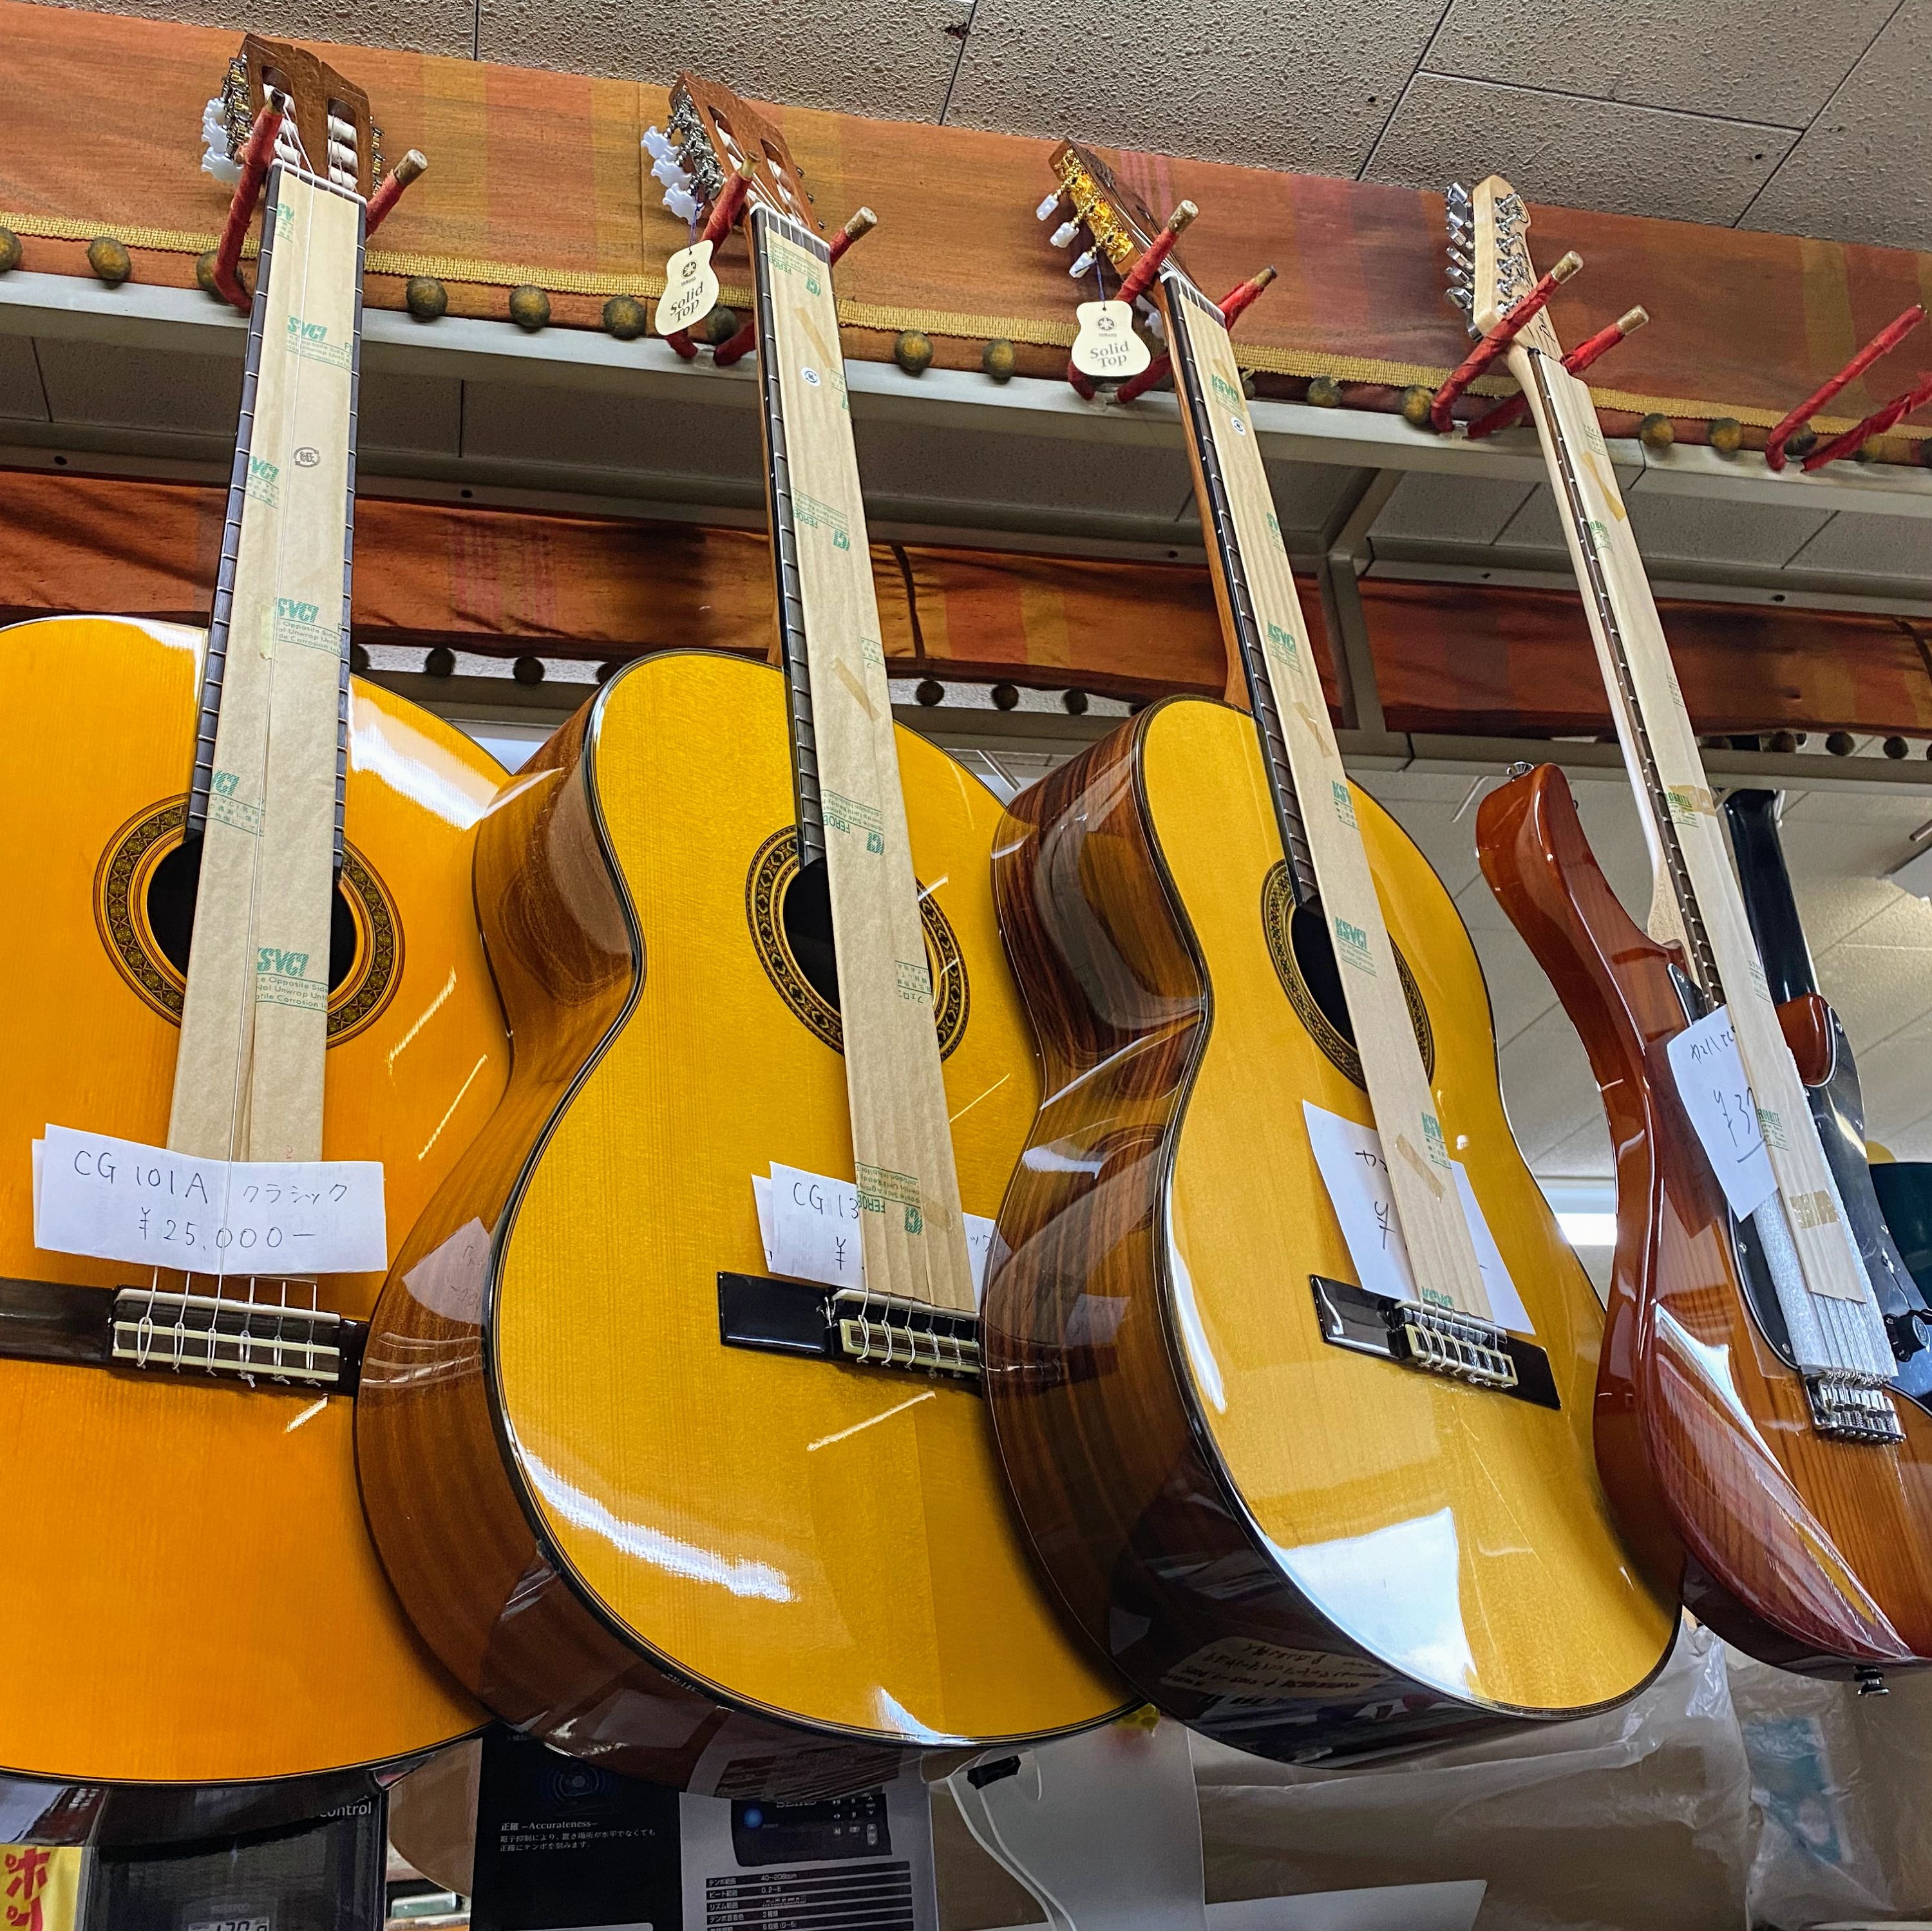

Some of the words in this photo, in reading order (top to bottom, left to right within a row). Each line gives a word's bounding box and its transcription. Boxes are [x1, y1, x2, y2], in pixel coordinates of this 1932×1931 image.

[670, 281, 703, 316] Solid
[674, 299, 699, 323] Top
[1090, 341, 1130, 359] Solid
[1097, 354, 1127, 368] Top
[283, 621, 320, 634] Opposite
[288, 629, 319, 641] Unwrap
[290, 636, 328, 649] Corrosion
[269, 977, 309, 989] Opposite
[274, 986, 308, 998] Unwrap
[277, 994, 318, 1008] Corrosion
[74, 1151, 114, 1183] CG
[136, 1166, 208, 1203] 101A
[243, 1183, 348, 1203] クラシック
[793, 1182, 824, 1215] CG
